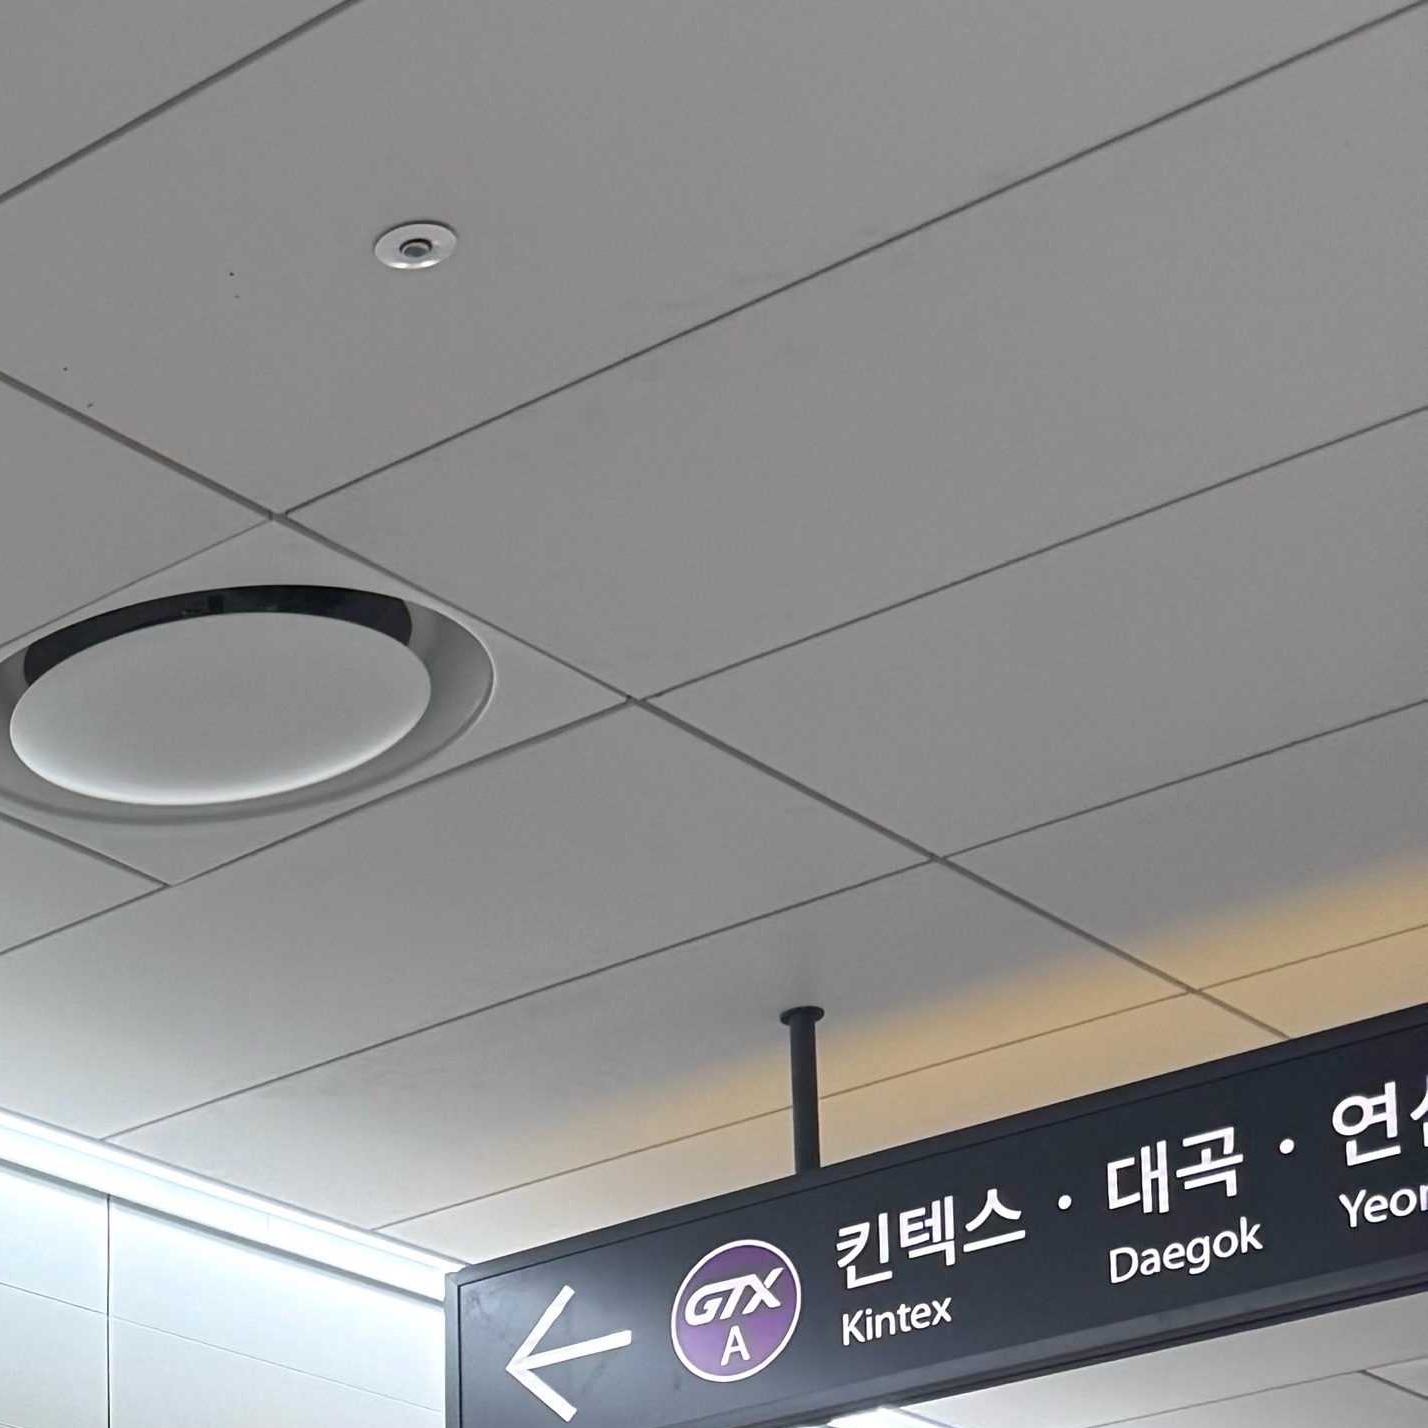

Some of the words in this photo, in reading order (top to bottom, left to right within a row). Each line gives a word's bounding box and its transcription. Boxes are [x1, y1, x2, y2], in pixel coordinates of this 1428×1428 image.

[836, 1188, 1026, 1289] 킨텍스
[1107, 1126, 1243, 1214] 대곡
[685, 1267, 783, 1325] GTX
[842, 1297, 952, 1346] Kintex
[1109, 1216, 1263, 1284] Daegok
[721, 1325, 751, 1366] A
